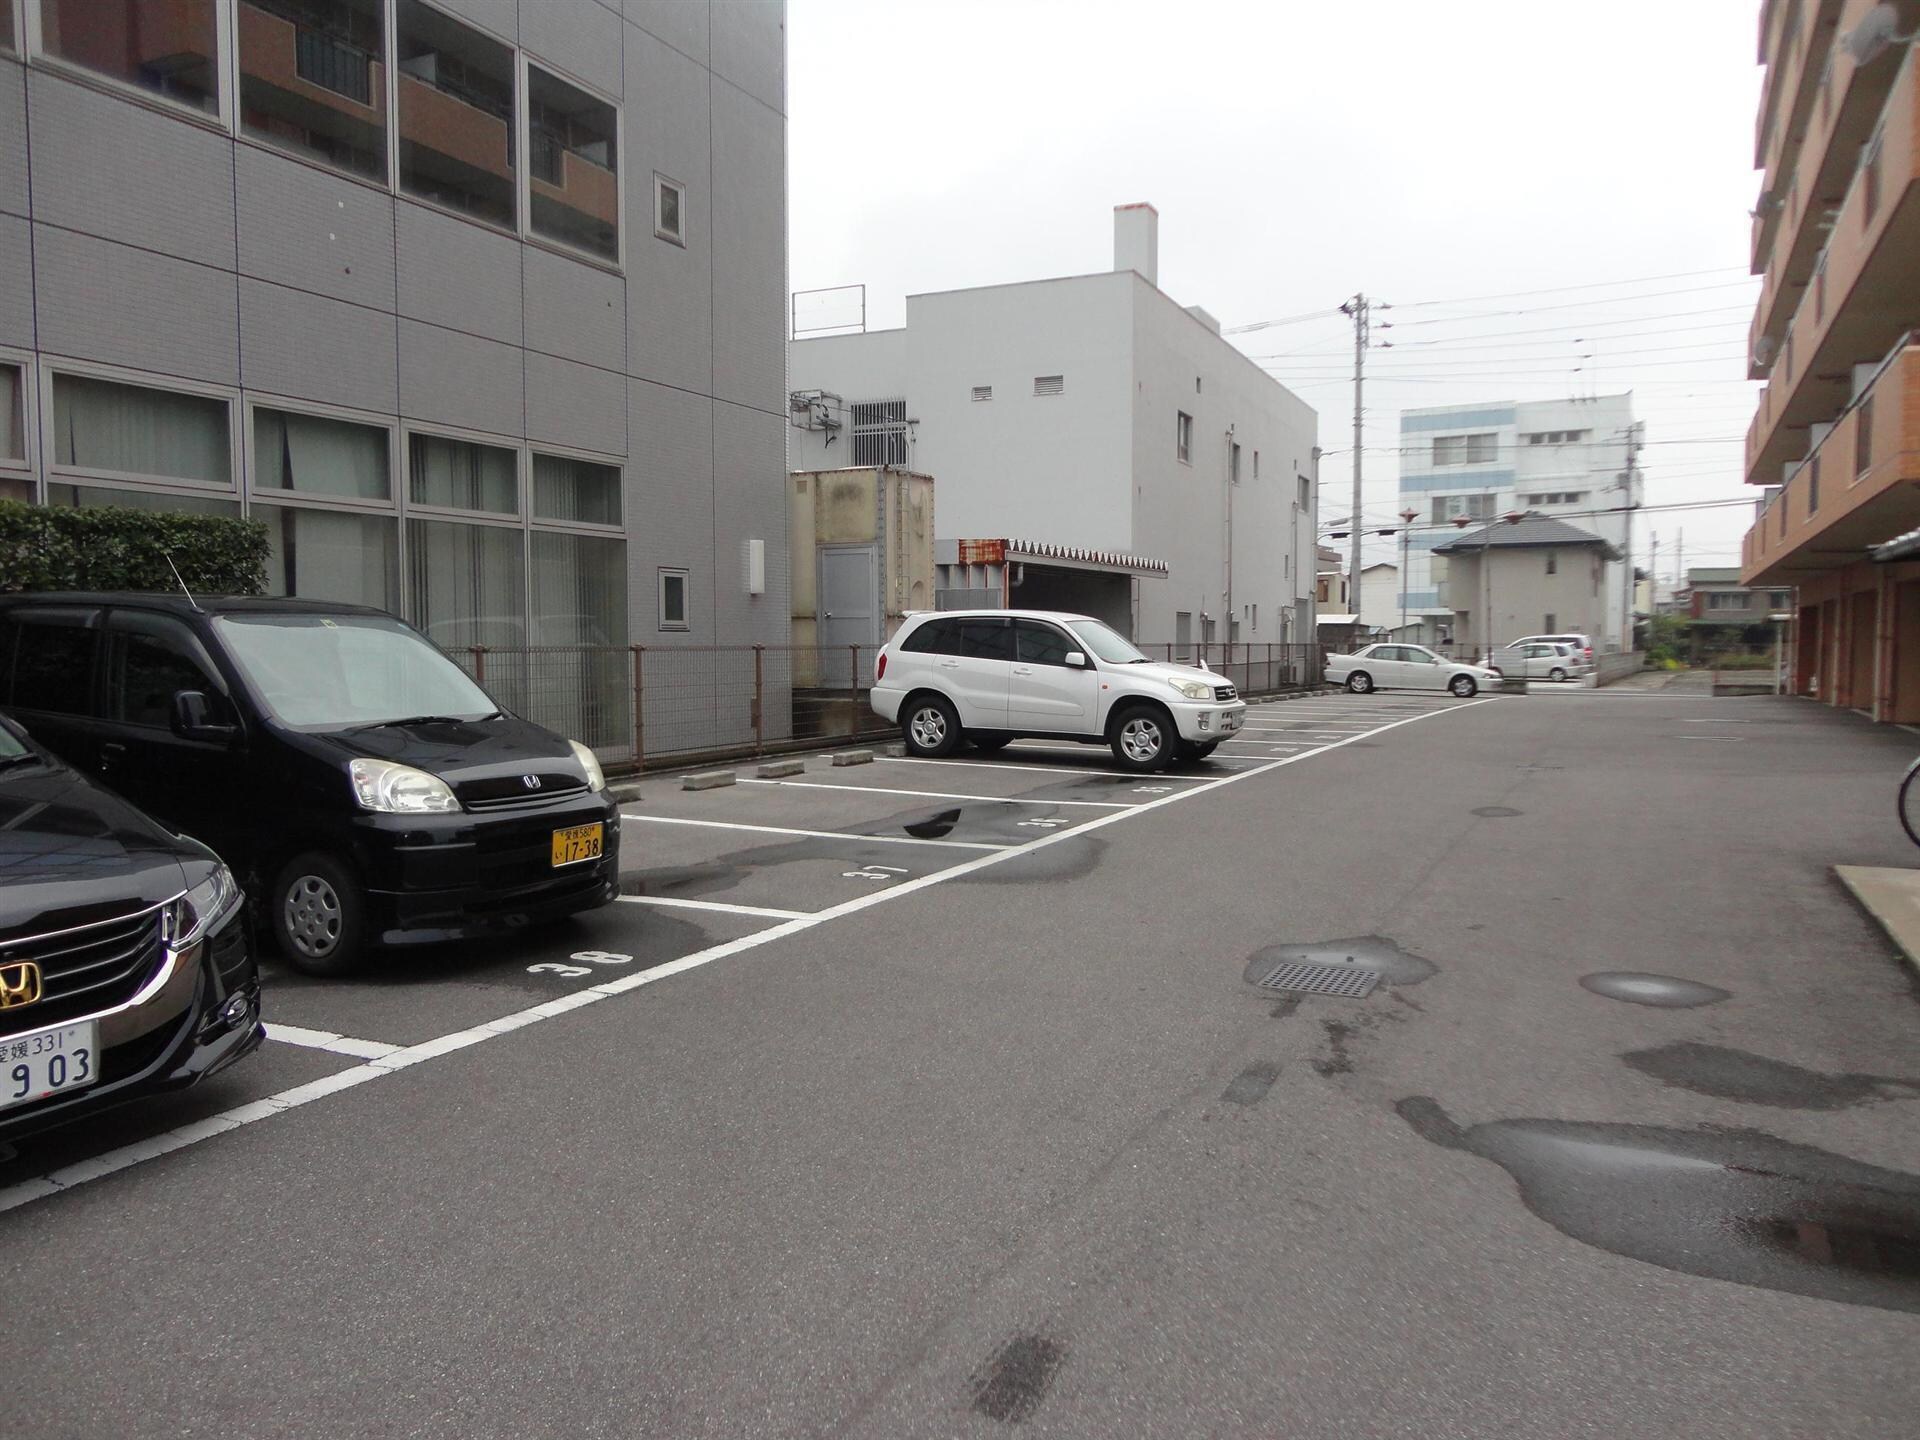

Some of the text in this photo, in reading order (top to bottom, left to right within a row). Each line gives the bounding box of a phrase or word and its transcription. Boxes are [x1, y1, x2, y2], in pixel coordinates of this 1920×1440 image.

[565, 837, 599, 863] 17-38
[842, 865, 909, 880] 37
[526, 950, 634, 977] 38
